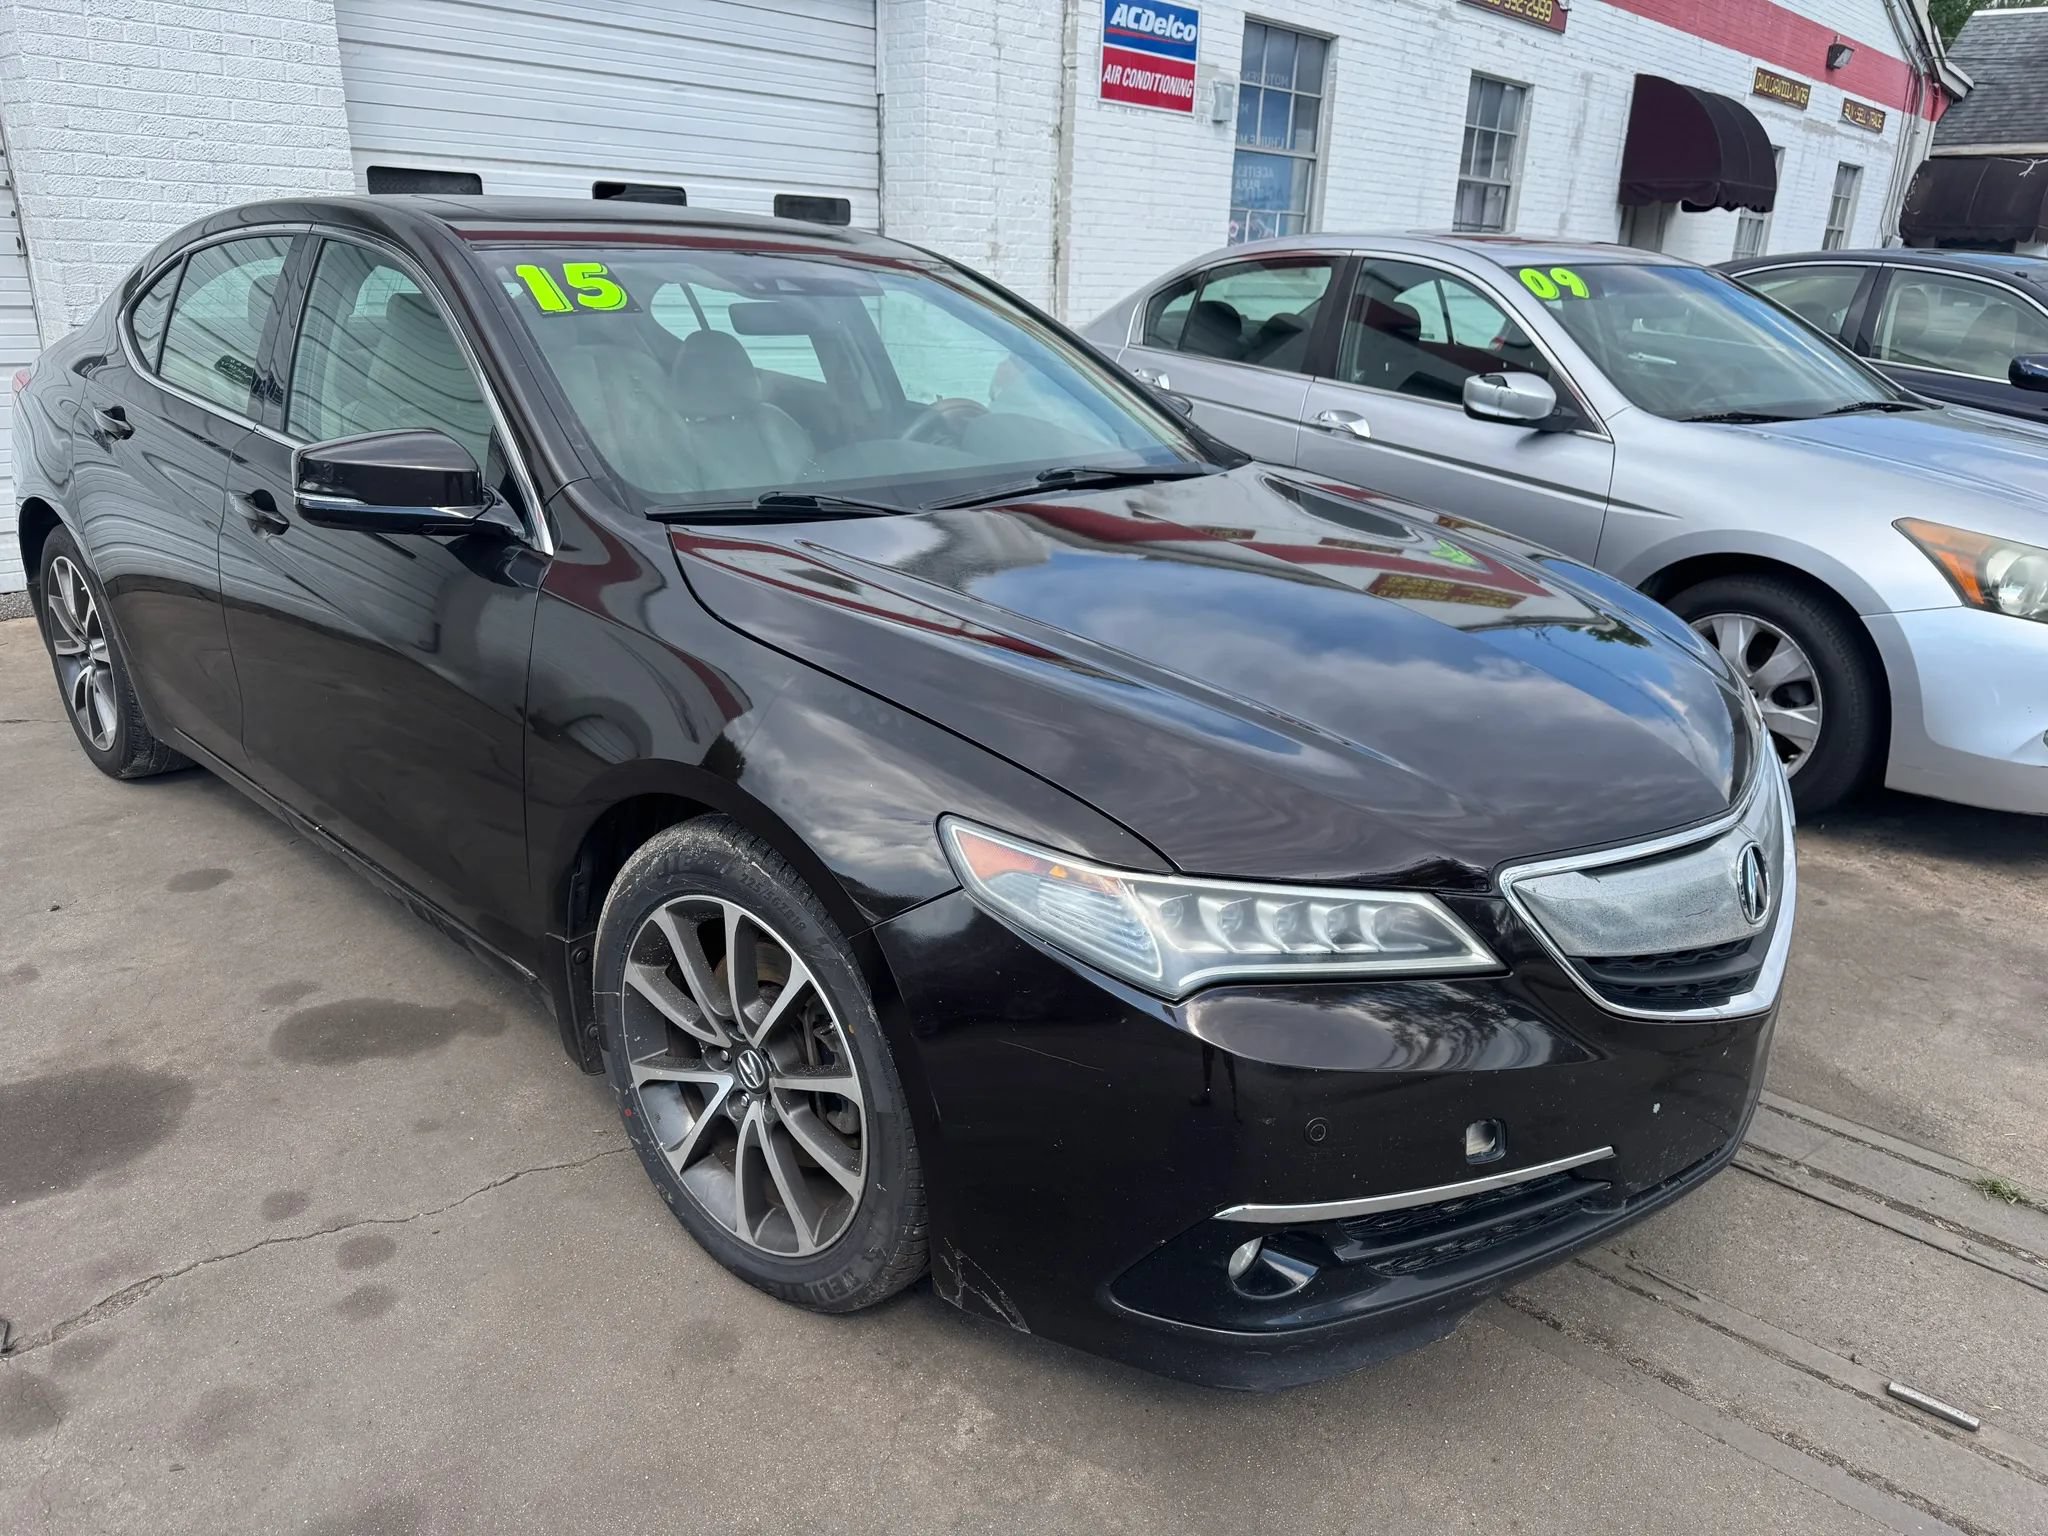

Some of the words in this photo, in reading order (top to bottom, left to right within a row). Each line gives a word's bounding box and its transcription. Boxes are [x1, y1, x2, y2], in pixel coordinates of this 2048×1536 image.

[1110, 3, 1197, 42] ACDelco
[1103, 63, 1123, 85] AIR
[1122, 66, 1194, 98] CONDITIONING
[515, 262, 628, 313] 15
[1519, 266, 1590, 300] 09
